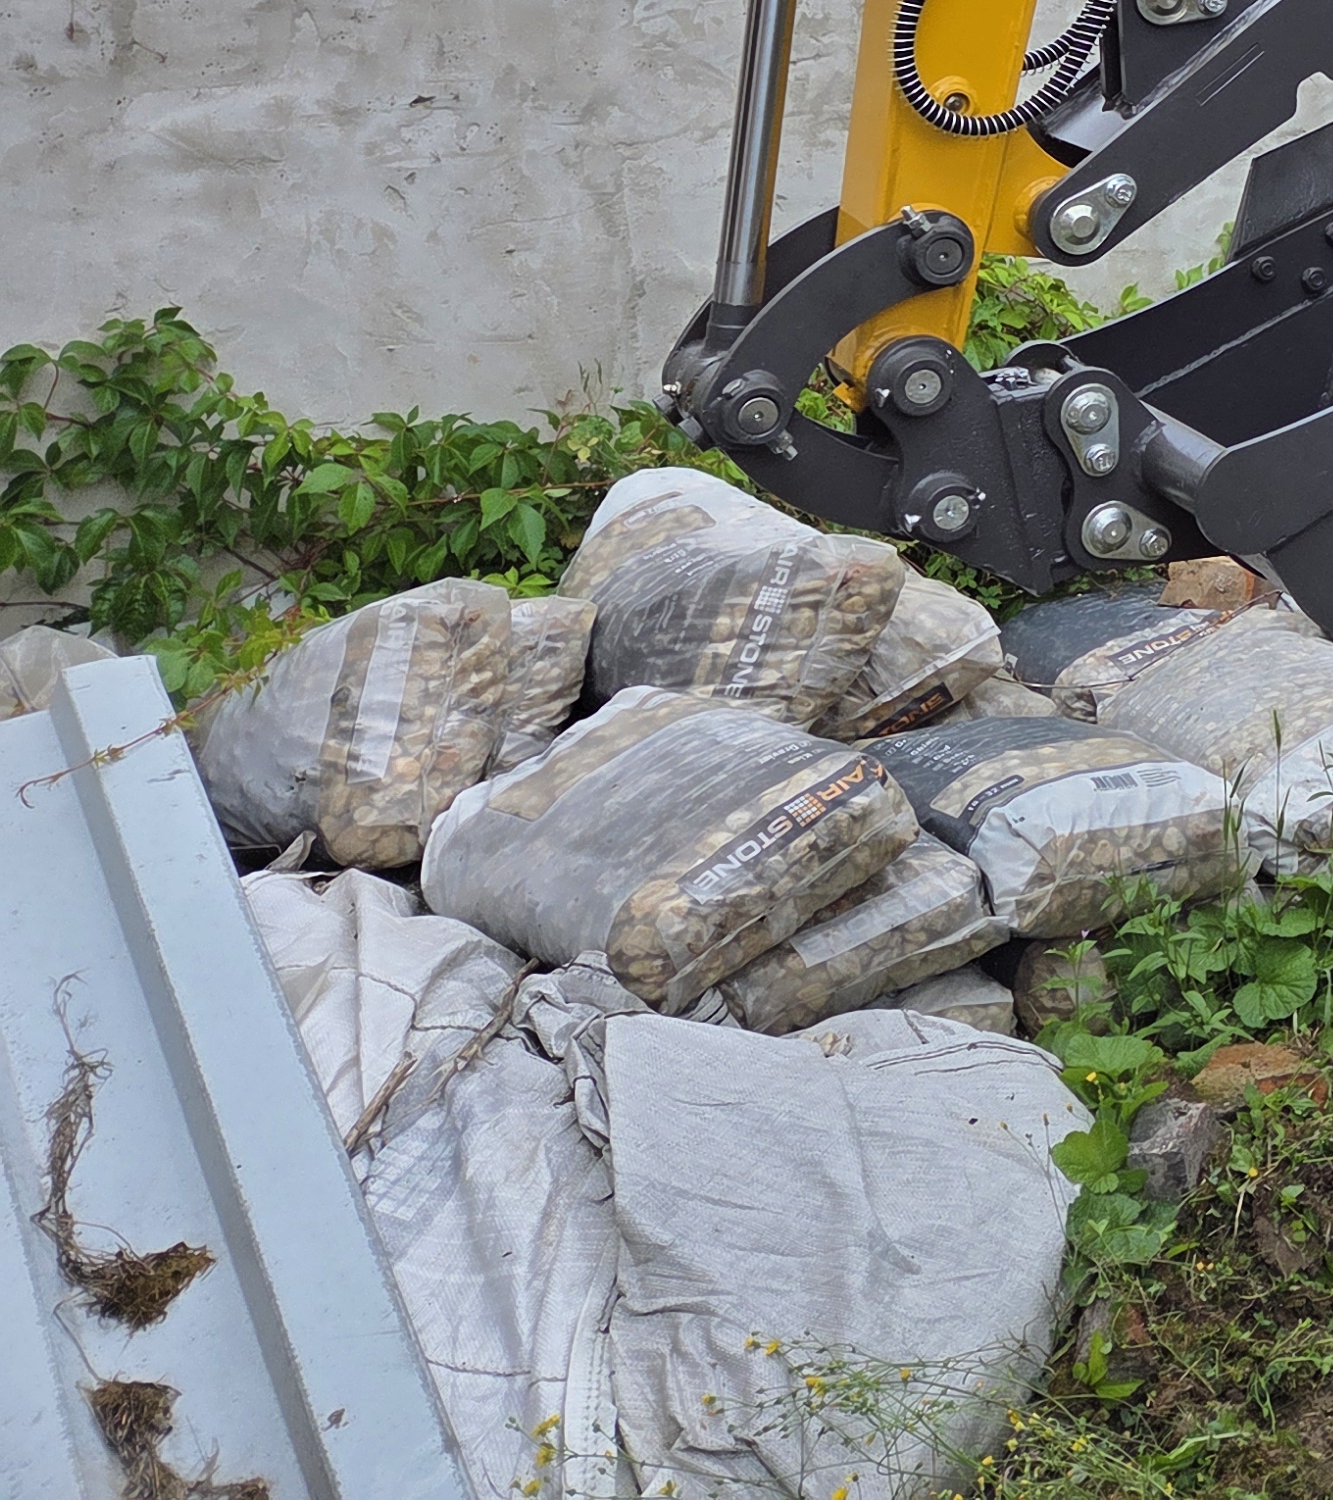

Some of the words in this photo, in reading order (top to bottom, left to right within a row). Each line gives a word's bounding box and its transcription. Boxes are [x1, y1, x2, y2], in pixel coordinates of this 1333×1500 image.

[724, 613, 773, 698] STONE
[1118, 629, 1192, 665] STONE
[879, 692, 945, 736] TONE
[693, 814, 794, 891] STONE
